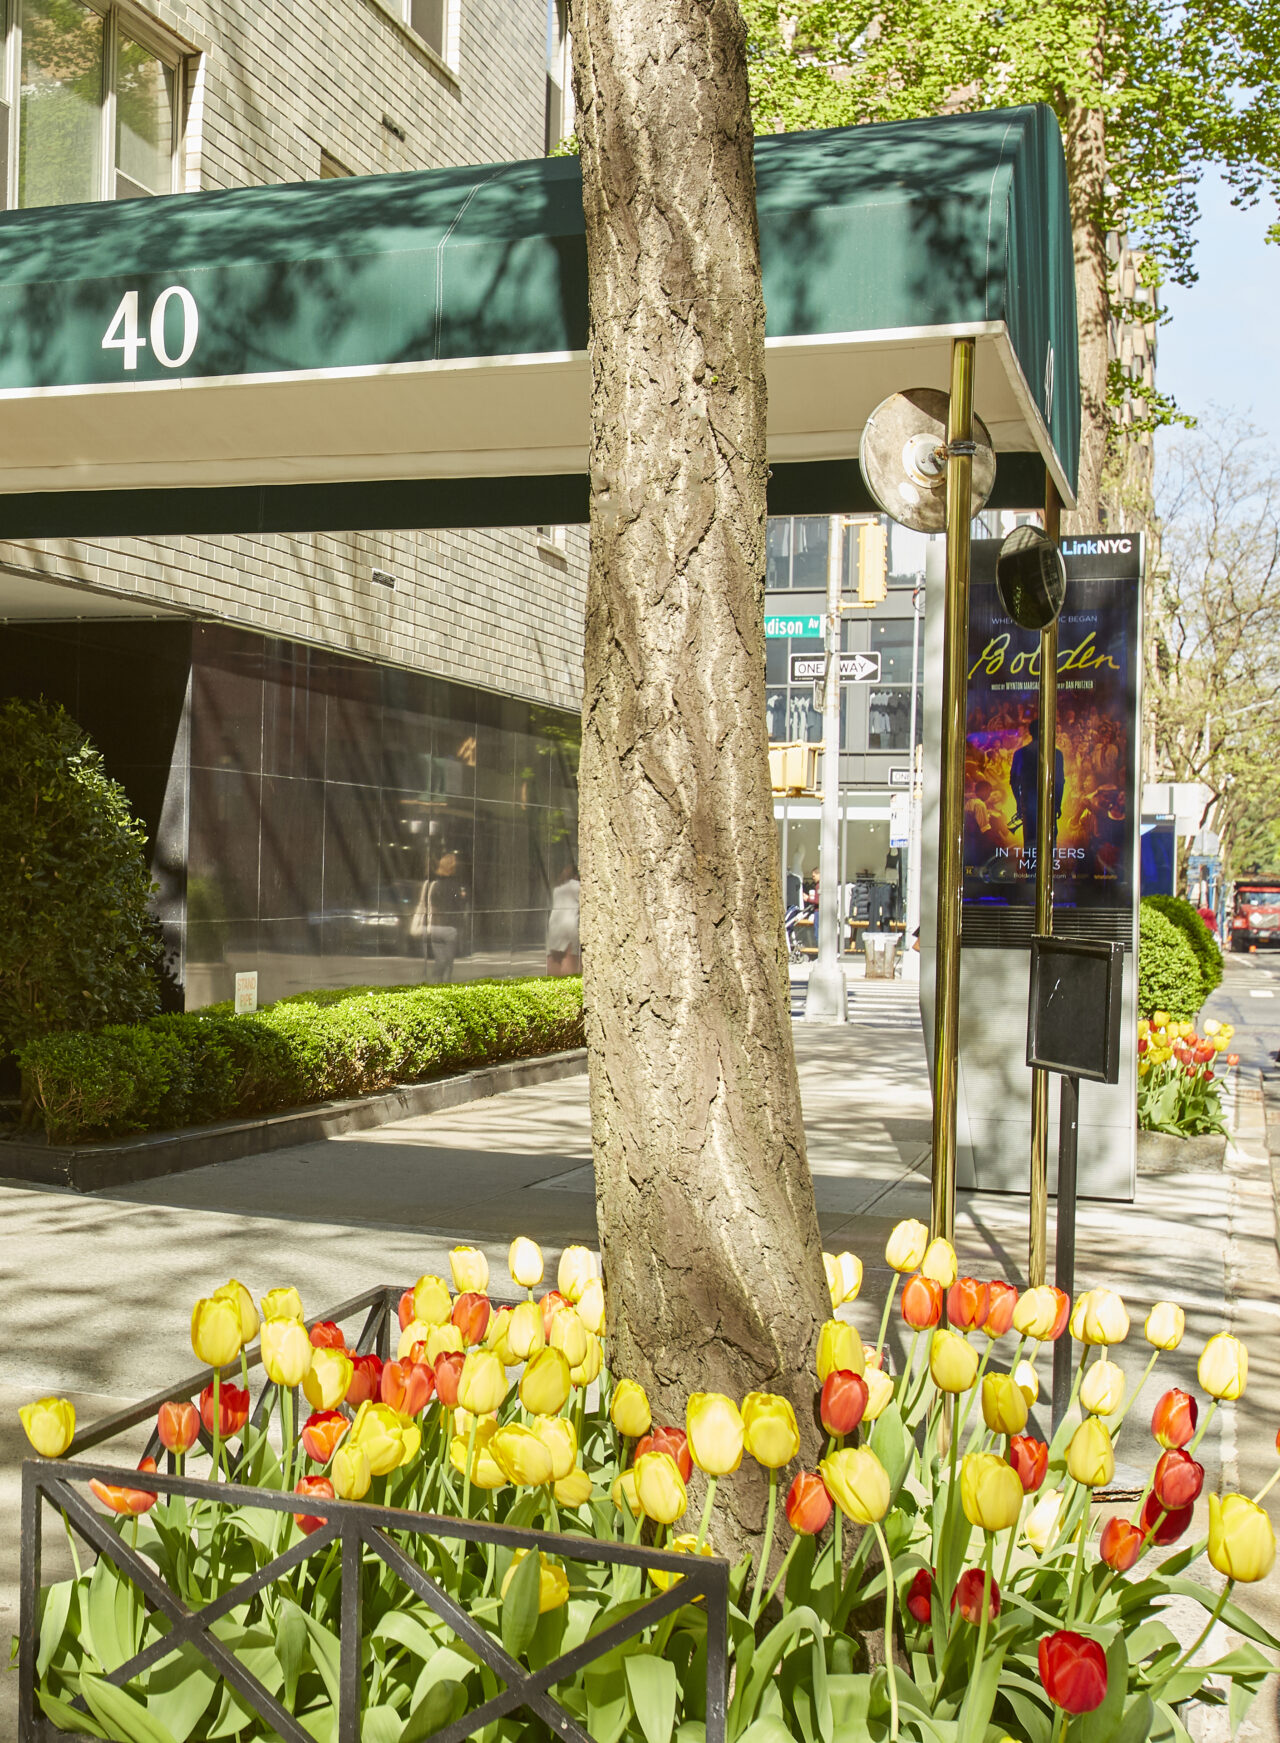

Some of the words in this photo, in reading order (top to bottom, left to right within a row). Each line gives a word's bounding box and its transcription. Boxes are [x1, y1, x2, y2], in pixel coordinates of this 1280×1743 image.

[102, 286, 198, 370] 40
[1062, 539, 1132, 555] LinkNYC
[1068, 615, 1098, 623] BEGAN
[766, 618, 803, 635] dison
[808, 618, 820, 629] Av
[798, 663, 823, 674] ONE
[840, 662, 867, 673] WAY
[995, 847, 1009, 858] IN
[1013, 847, 1086, 859] THETERS
